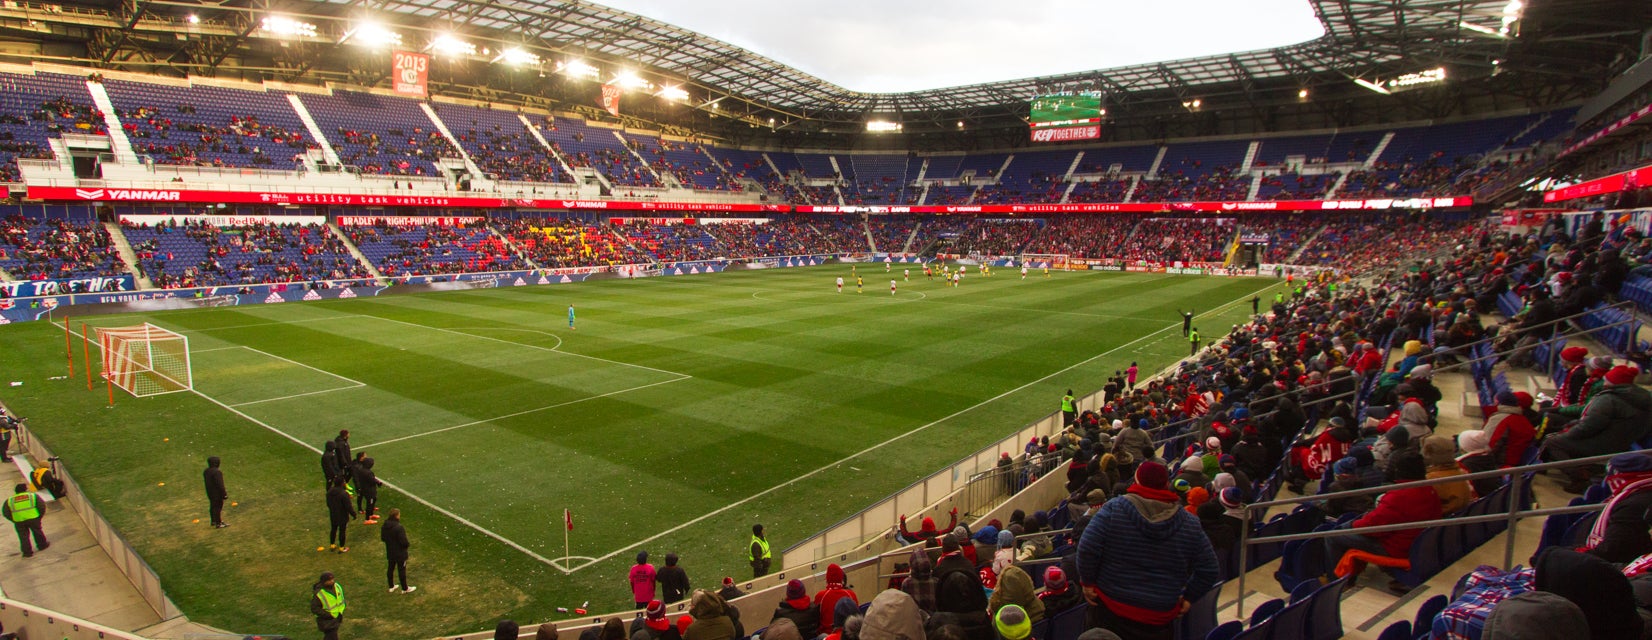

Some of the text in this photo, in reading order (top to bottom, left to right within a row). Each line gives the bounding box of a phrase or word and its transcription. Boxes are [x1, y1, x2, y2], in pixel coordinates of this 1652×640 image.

[396, 53, 426, 72] 2013
[107, 190, 180, 200] YANMAR
[297, 194, 351, 204] utility
[361, 196, 388, 204] task
[397, 197, 449, 205] vehicles
[575, 201, 607, 209] YANMAR
[659, 202, 684, 210] utility
[1083, 203, 1120, 211] vehicles
[1237, 202, 1277, 210] YANMAR
[343, 217, 480, 226] BRADLEY RIGHT-PHILLIPS 69 GOAL
[32, 276, 126, 297] TOETHR
